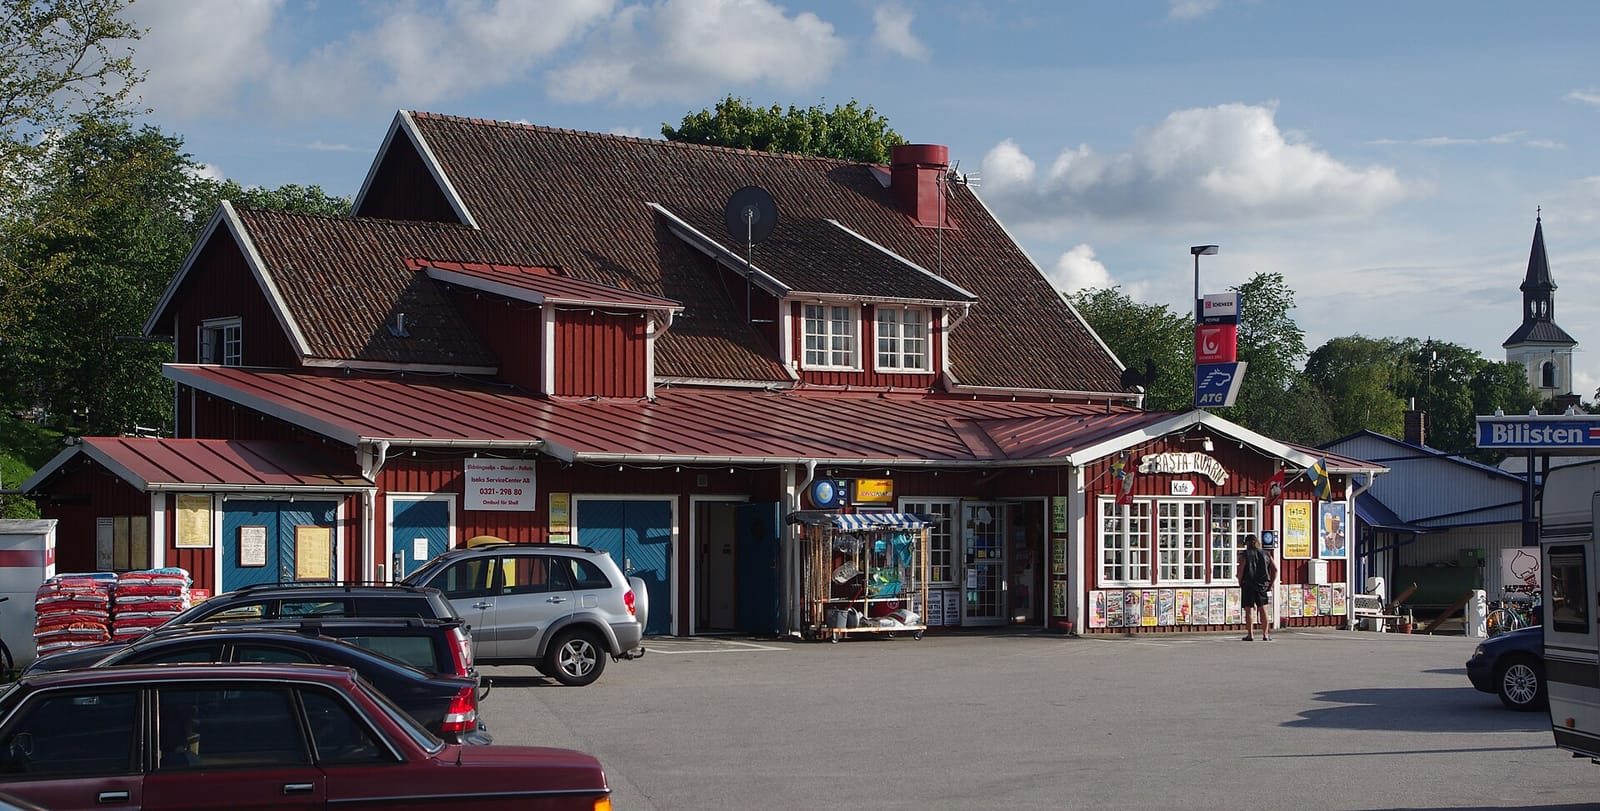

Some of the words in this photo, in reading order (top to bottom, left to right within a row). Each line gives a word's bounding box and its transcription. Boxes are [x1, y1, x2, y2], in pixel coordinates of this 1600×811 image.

[1200, 393, 1222, 403] ATG
[1492, 423, 1583, 444] Bilisten
[500, 488, 512, 496] 298
[1289, 508, 1306, 516] 1+1=3
